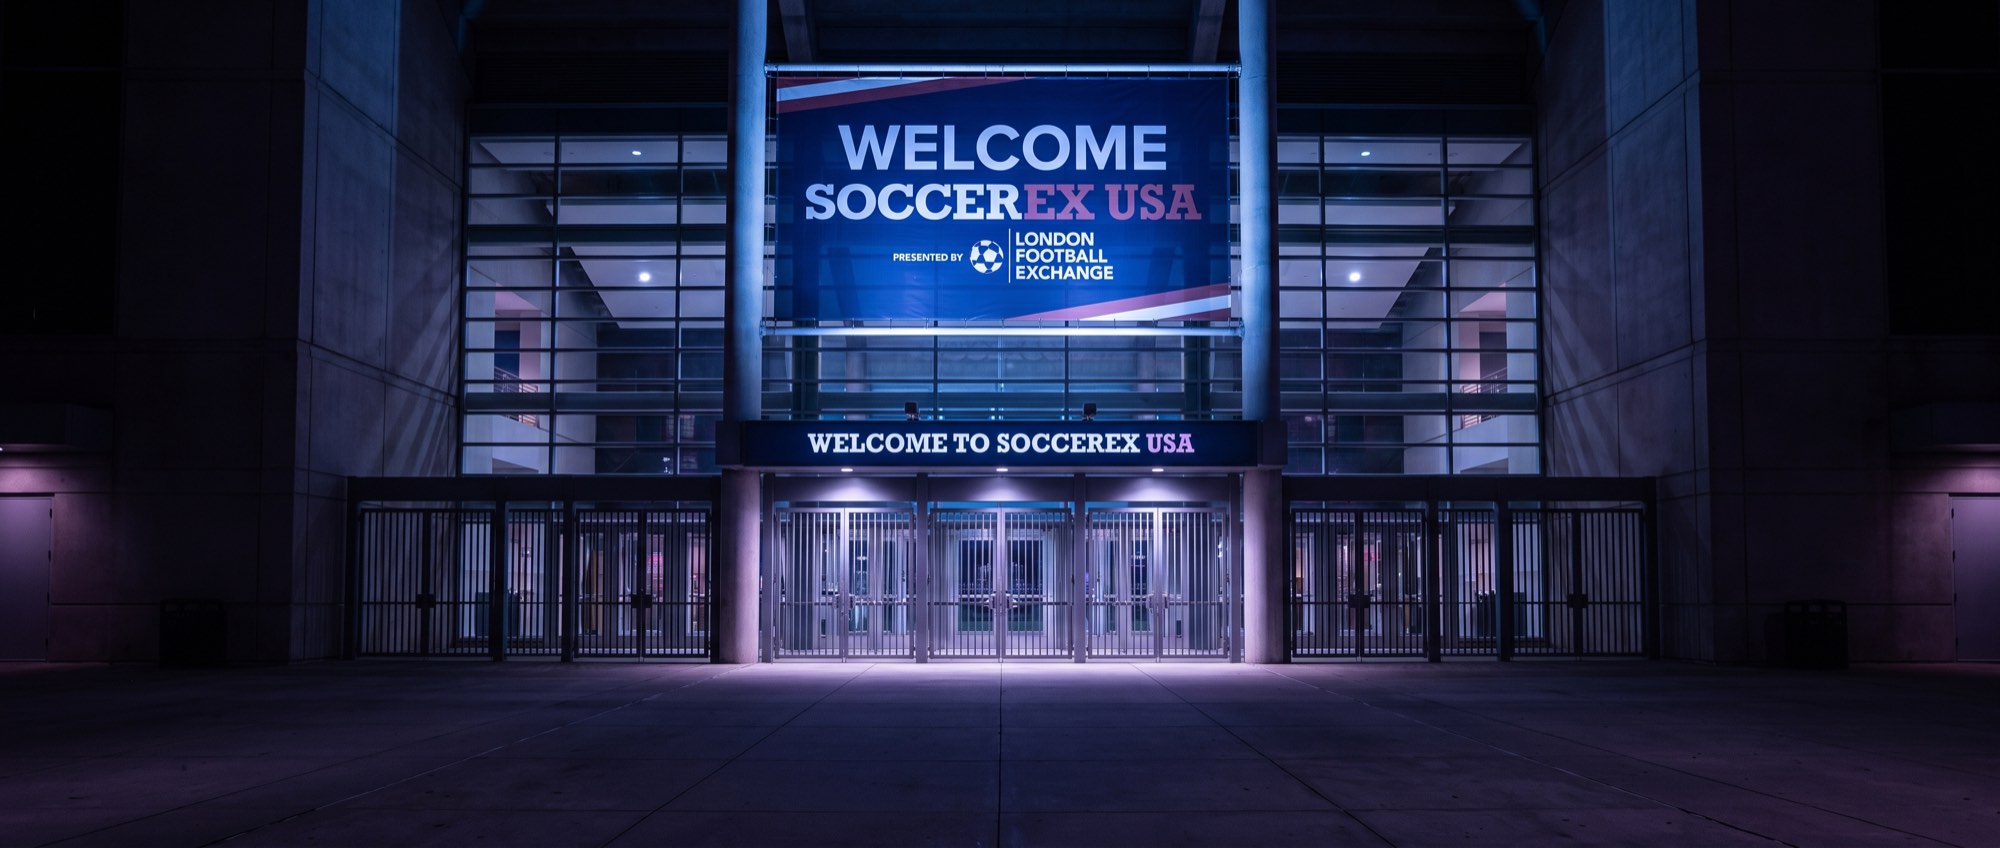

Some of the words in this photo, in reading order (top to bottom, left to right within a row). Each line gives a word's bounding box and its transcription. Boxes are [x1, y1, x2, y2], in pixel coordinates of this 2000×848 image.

[839, 125, 1166, 171] WELCOME
[806, 184, 1094, 220] SOCCEREX
[1105, 184, 1201, 220] USA
[1016, 232, 1094, 246] LONDON
[893, 253, 948, 261] PRESENTED
[1016, 249, 1107, 263] FOOTBALL
[1016, 266, 1113, 280] EXCHANGE
[808, 433, 947, 453] WELCOME
[953, 433, 989, 453] TO
[997, 433, 1140, 453] SOCCEREX
[1146, 434, 1194, 453] USA
